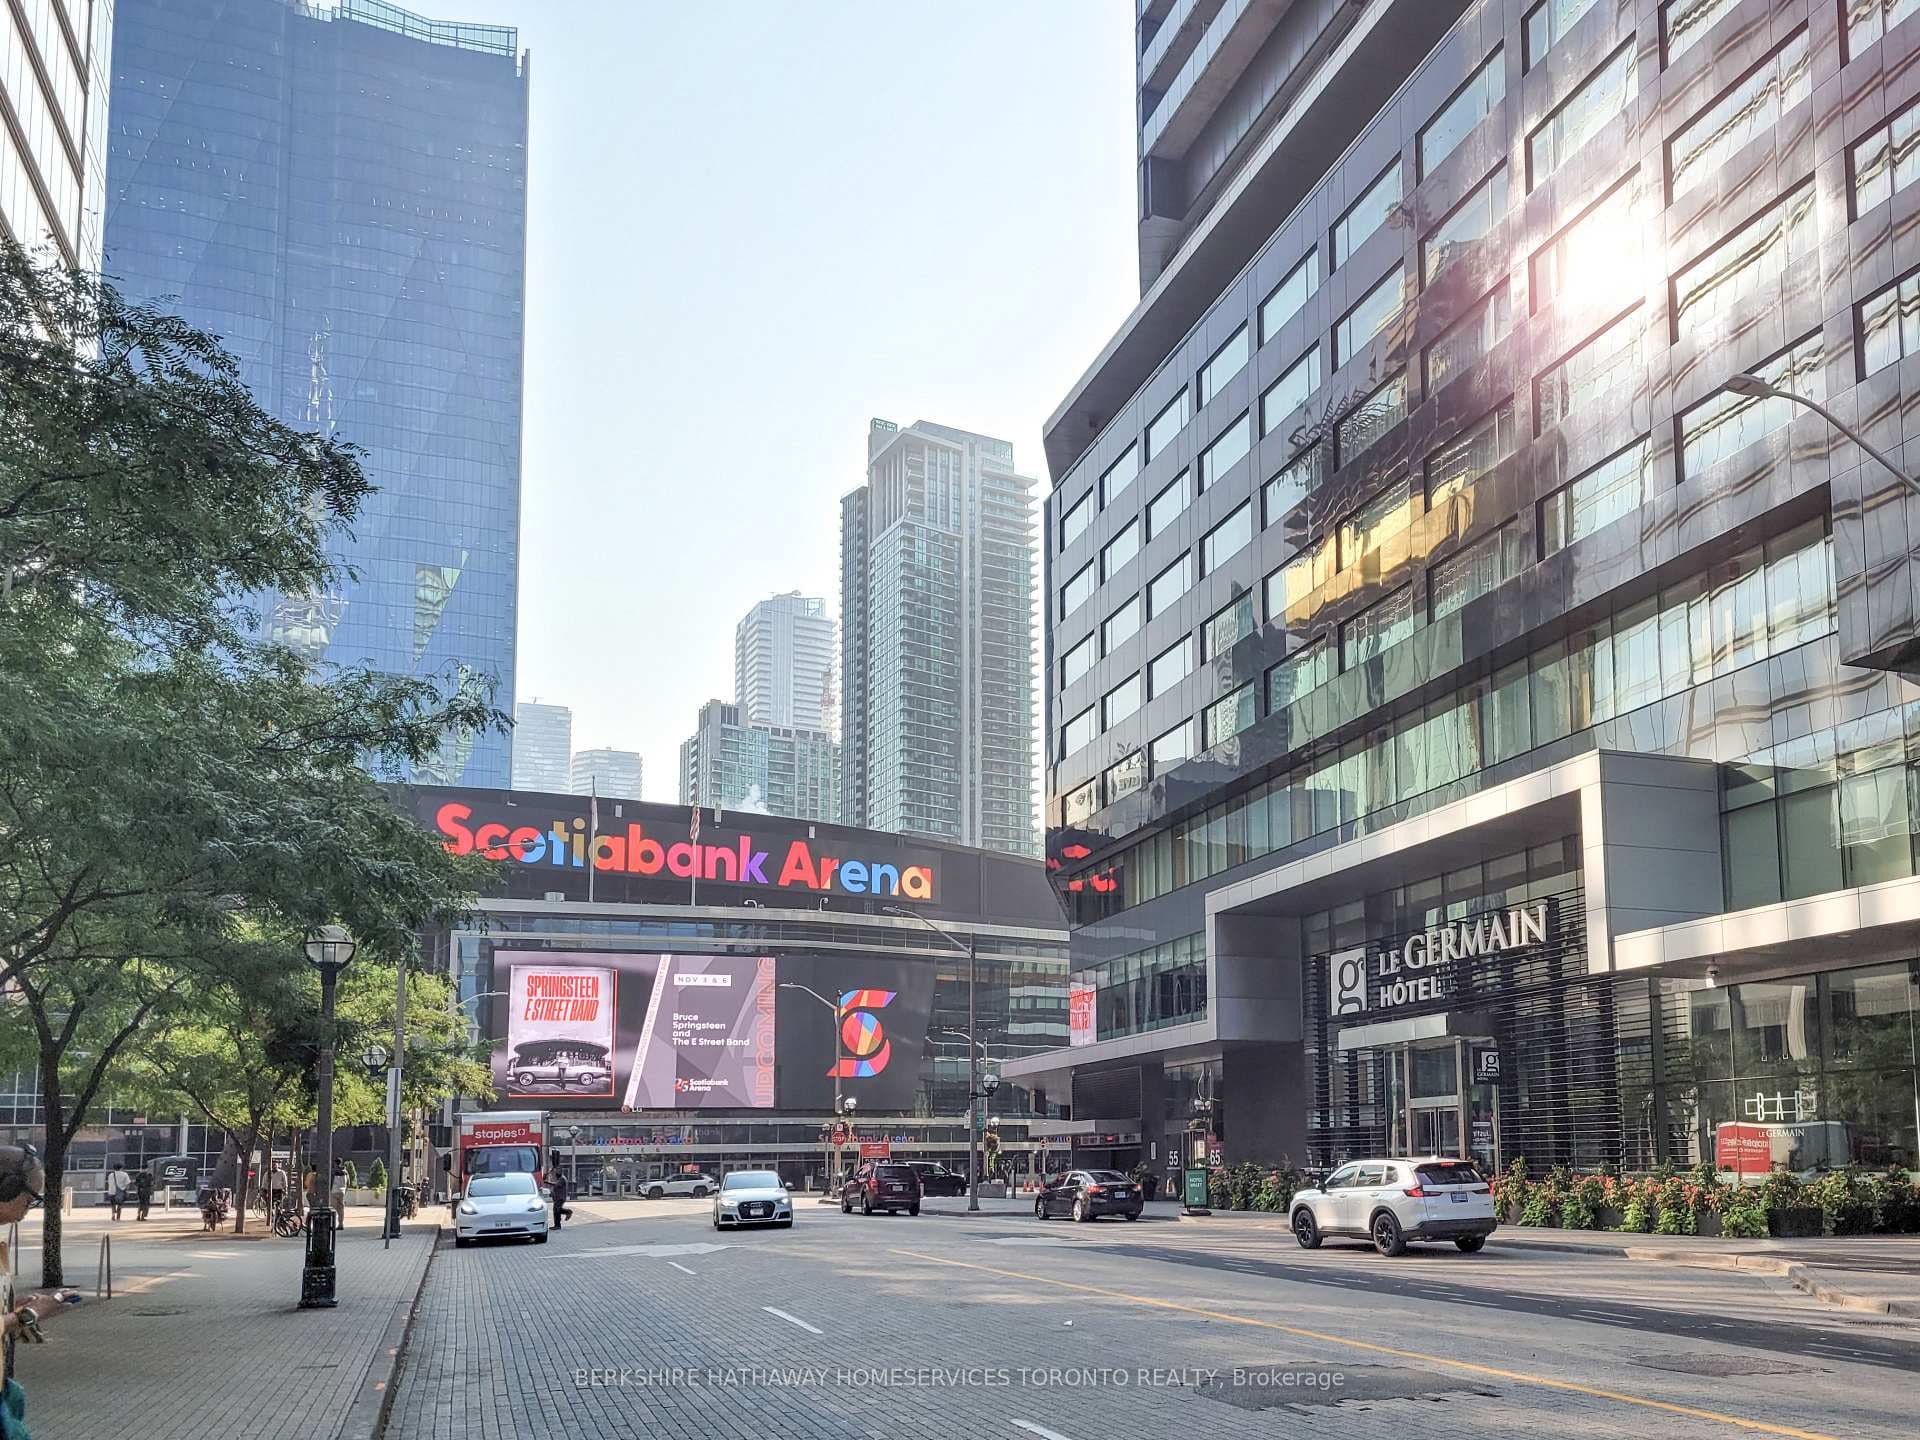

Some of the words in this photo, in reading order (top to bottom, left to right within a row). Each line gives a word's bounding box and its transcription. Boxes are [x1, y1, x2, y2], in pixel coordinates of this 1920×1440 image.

[435, 802, 769, 885] Scotiabank
[778, 840, 932, 898] Arena
[1378, 949, 1400, 976] LE
[1404, 904, 1548, 969] GERMAIN
[527, 975, 599, 998] SPRINGSTEEN
[1380, 976, 1443, 1008] HÔTEL
[524, 999, 532, 1021] E
[532, 1000, 572, 1021] STREET
[570, 1000, 599, 1022] BAND
[672, 1013, 699, 1021] Bruce
[672, 1021, 726, 1030] Springsteen
[755, 958, 775, 1107] UPCOMING
[672, 1030, 691, 1038] and
[672, 1038, 689, 1046] The
[691, 1038, 697, 1046] E
[698, 1038, 725, 1046] Street
[726, 1038, 750, 1046] Band
[689, 1078, 729, 1086] Scotiabank
[632, 1105, 643, 1113] LG
[1756, 1090, 1804, 1122] BAR
[475, 1129, 517, 1140] staples
[1758, 1130, 1766, 1138] LE
[1766, 1128, 1806, 1137] GERMAIN
[1169, 1151, 1179, 1166] 55
[1210, 1150, 1221, 1165] 65
